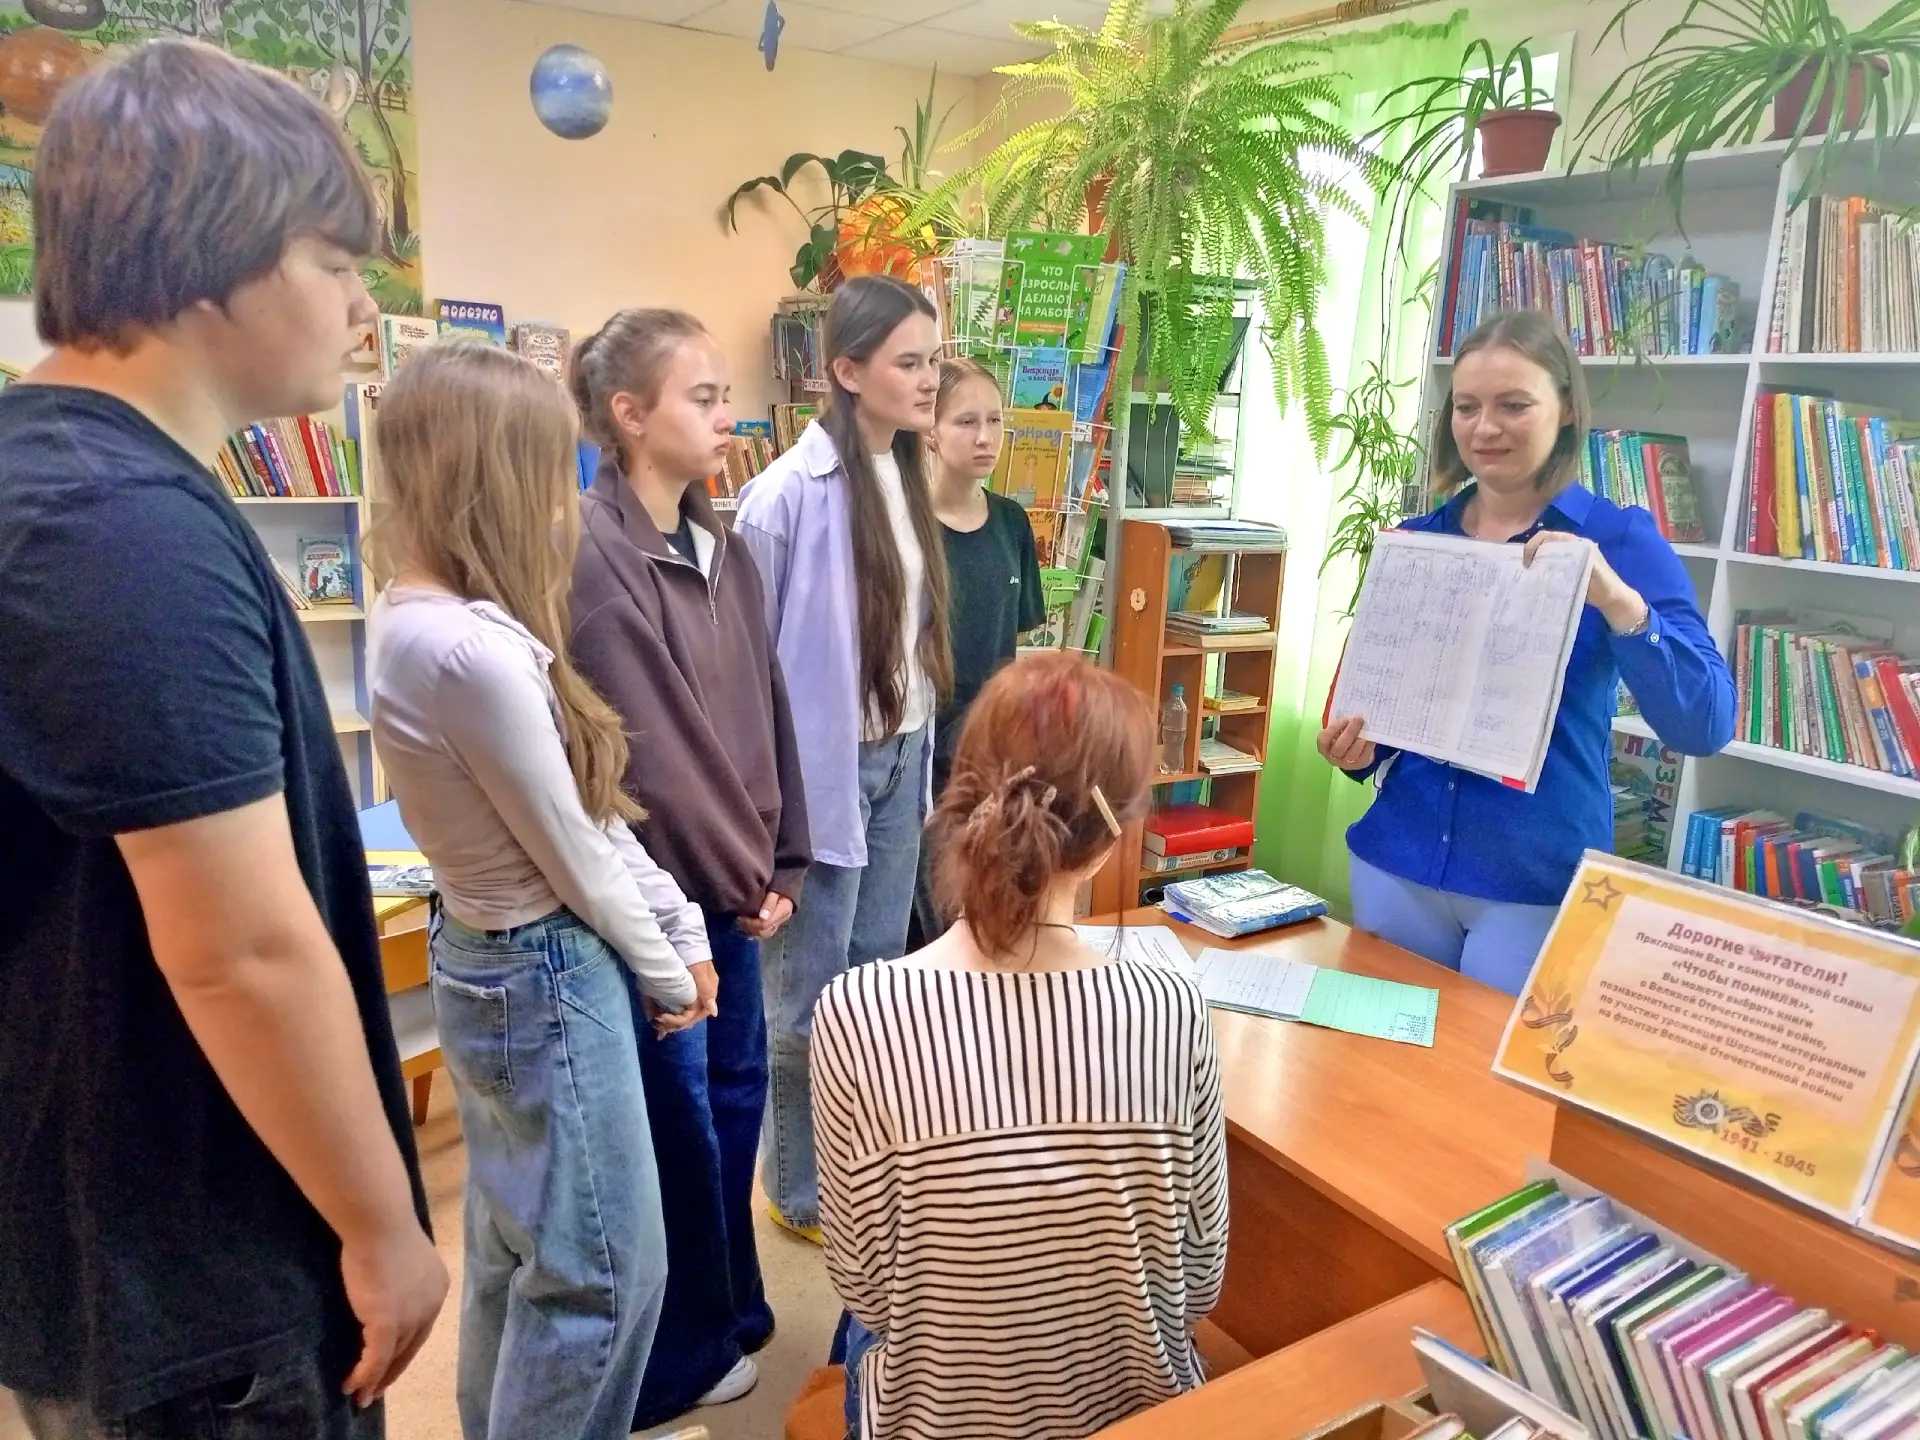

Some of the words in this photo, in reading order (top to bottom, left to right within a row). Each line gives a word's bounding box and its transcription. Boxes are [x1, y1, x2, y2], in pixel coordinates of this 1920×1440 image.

[1023, 293, 1071, 305] ДЕЛАЮТ
[1041, 265, 1063, 276] ЧТО
[1034, 307, 1075, 318] РАБОТЕ
[1667, 922, 1744, 955] Дорогие
[1636, 932, 1704, 959] Приглашаем
[1706, 953, 1725, 967] Вас
[1728, 961, 1735, 969] в
[1737, 964, 1785, 985] комнату
[1785, 977, 1831, 999] боевой
[1833, 994, 1873, 1013] славы
[1662, 972, 1679, 984] Вы
[1681, 979, 1724, 999] можете
[1726, 994, 1774, 1015] выбрать
[1776, 1010, 1814, 1029] книги
[1600, 979, 1681, 1013] познакомиться
[1691, 1012, 1779, 1047] историческими
[1780, 1043, 1867, 1079] материалами
[1600, 993, 1613, 1004] по
[1614, 999, 1660, 1021] участию
[1661, 1016, 1723, 1042] уроженцев
[1806, 1067, 1854, 1090] района
[1648, 981, 1697, 1004] Великой
[1698, 998, 1785, 1033] Отечественной
[1786, 1029, 1827, 1050] войне,
[1598, 1008, 1612, 1018] на
[1613, 1012, 1659, 1034] фронтах
[1660, 1028, 1708, 1052] Великой
[1710, 1047, 1799, 1086] Отечественной
[1801, 1080, 1843, 1102] войны
[1720, 1129, 1759, 1153] 1941
[1773, 1151, 1816, 1177] 1945
